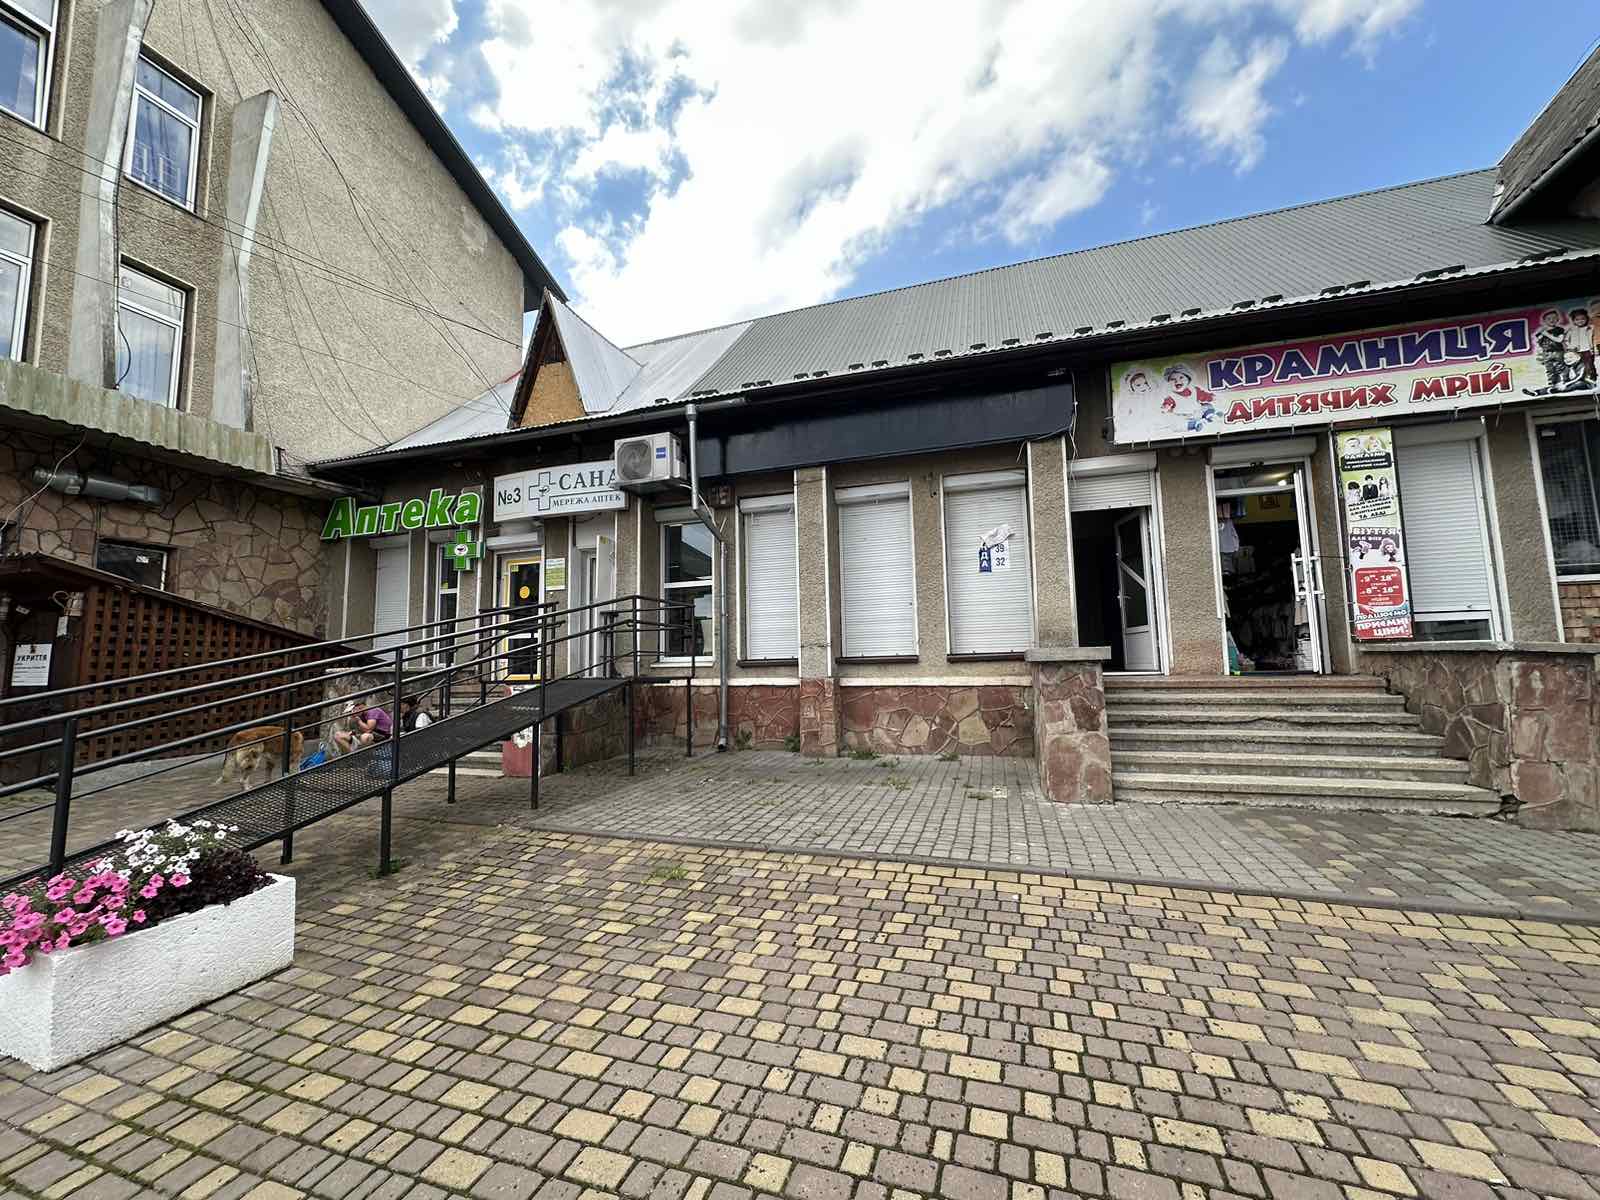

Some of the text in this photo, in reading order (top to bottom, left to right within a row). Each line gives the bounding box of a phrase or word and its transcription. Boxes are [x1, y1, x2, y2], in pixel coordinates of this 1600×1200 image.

[1207, 318, 1531, 391] КРАМНИЦЯ
[1225, 362, 1513, 424] ДИТЯЧИХ МРІЙ
[320, 488, 480, 540] Аптека
[498, 487, 521, 506] №3
[553, 494, 621, 507] МЕРЕЖА АПТЕК
[996, 557, 1005, 566] 32
